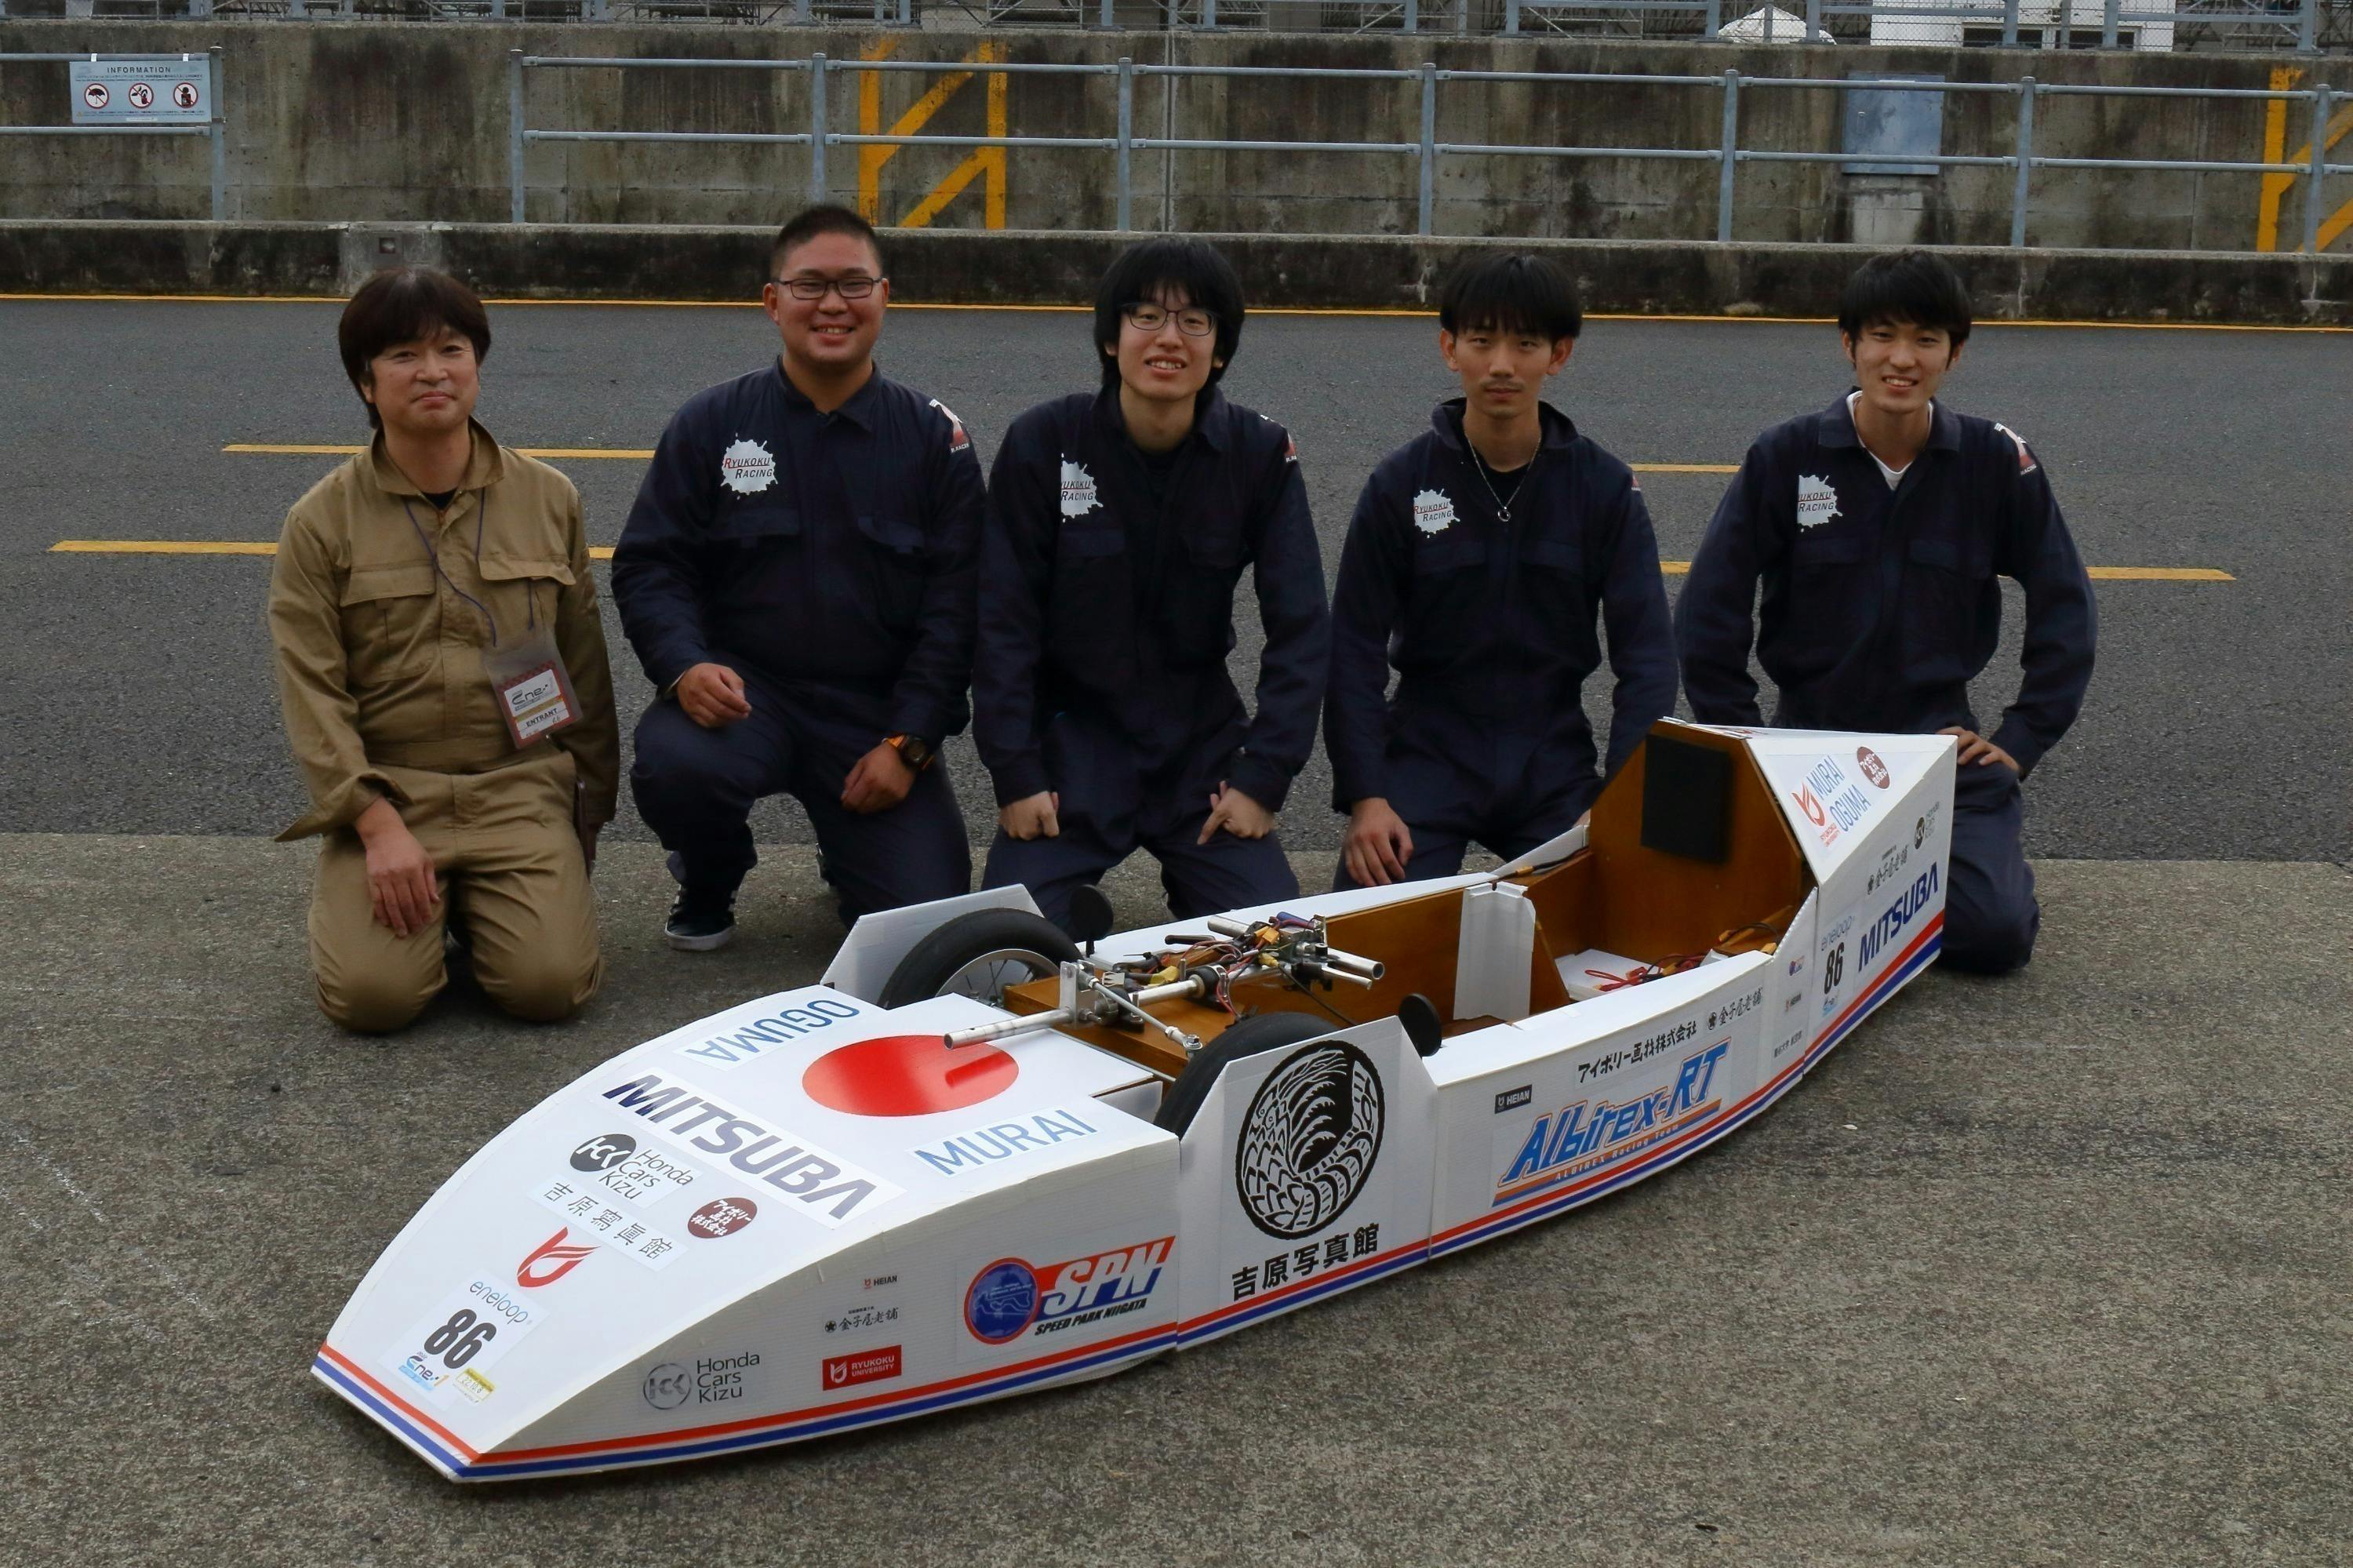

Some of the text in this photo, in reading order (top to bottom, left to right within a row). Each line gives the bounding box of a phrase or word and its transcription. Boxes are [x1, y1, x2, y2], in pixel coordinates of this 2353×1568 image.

[723, 458, 770, 469] RYUKOKU
[735, 469, 773, 478] RACING
[1061, 480, 1091, 489] UKOKU
[1061, 491, 1093, 500] RACING
[1798, 491, 1831, 501] UKOKU
[1413, 502, 1449, 514] RYUKOKU
[1423, 510, 1452, 522] RACING
[1798, 502, 1834, 512] RACING
[526, 708, 558, 727] ENTRANT
[1806, 755, 1845, 800] MURAI
[1830, 784, 1871, 831] OGUMA
[1858, 861, 1938, 973] MITSUBA
[1821, 915, 1853, 951] eneloop
[1824, 942, 1845, 995] 86
[684, 999, 860, 1062] OGUMA
[1578, 1020, 1697, 1083] アイボリー画材株式会社
[1507, 1090, 1529, 1105] HEIAN
[601, 1075, 877, 1221] MITSUBA
[914, 1109, 1097, 1174] MURAI
[1555, 1124, 1679, 1181] ALBIREX Racing Team
[618, 1161, 661, 1188] Cars
[634, 1148, 693, 1186] Honda
[598, 1170, 642, 1199] Kizu
[713, 1199, 751, 1221] アイボリー
[1232, 1222, 1380, 1301] 吉原写真館
[874, 1275, 897, 1286] HEIAN
[1043, 1240, 1167, 1315] SPN
[470, 1281, 529, 1325] eneloop
[1035, 1298, 1147, 1336] SPEED PARK NIIGATA
[424, 1308, 497, 1370] 86
[697, 1352, 760, 1373] Honda
[851, 1355, 895, 1370] RYUKOKU
[851, 1363, 895, 1377] UNIVERSITY
[697, 1372, 742, 1388] Cars
[699, 1387, 743, 1403] Kizu
